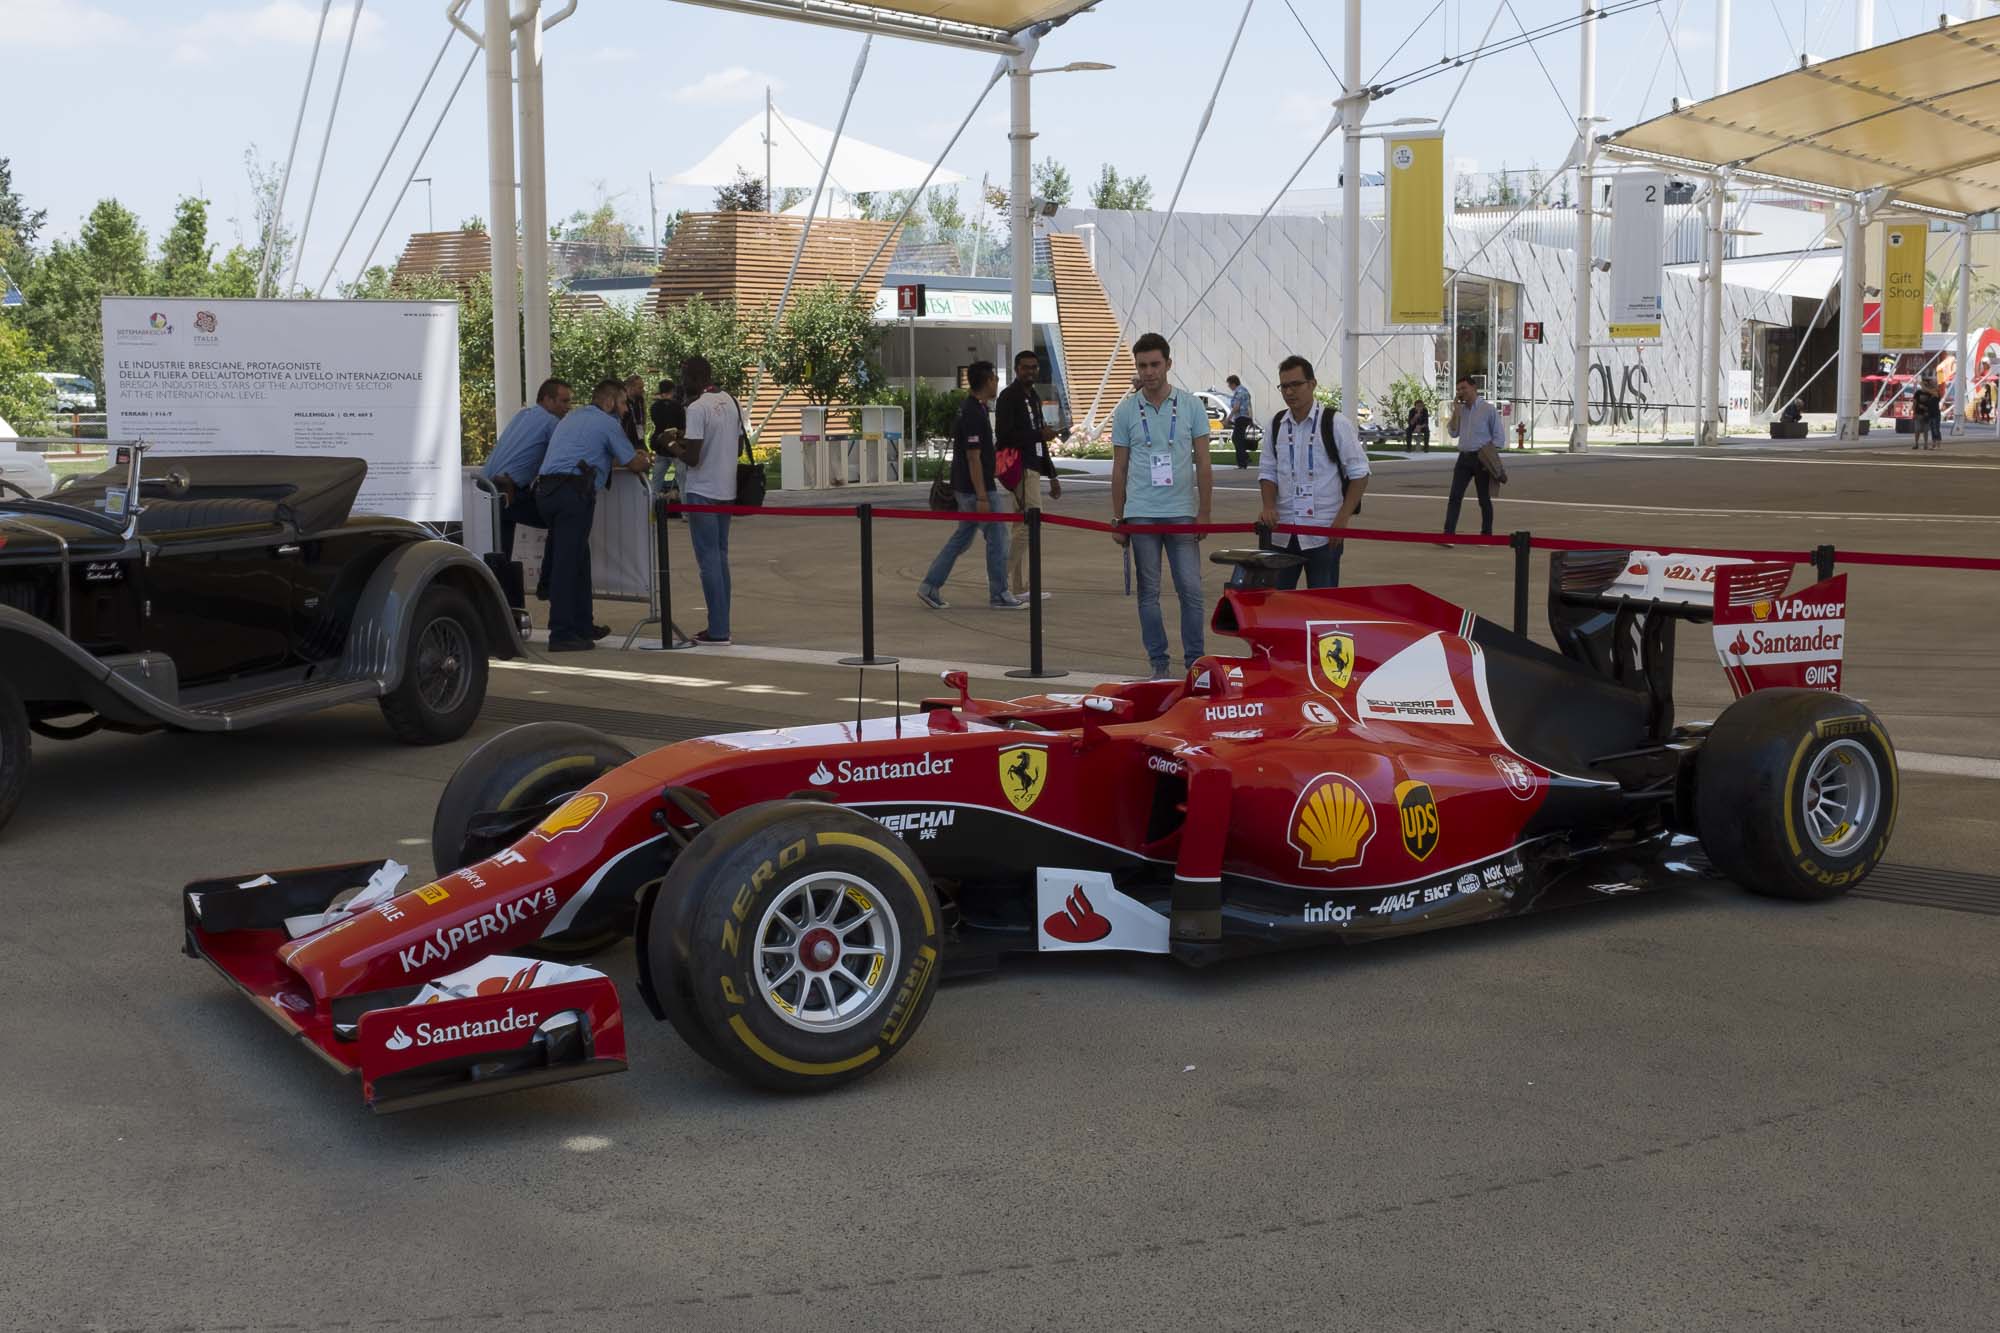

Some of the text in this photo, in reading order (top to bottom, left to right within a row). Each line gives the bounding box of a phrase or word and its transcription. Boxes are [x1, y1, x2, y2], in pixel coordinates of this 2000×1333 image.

[1645, 185, 1657, 203] 2
[1889, 272, 1912, 285] Gift
[1889, 286, 1921, 300] Shop
[924, 297, 952, 314] TESA
[118, 361, 321, 371] LE INDUSTRIE BRESCIANE, PROTAGONISTE
[119, 370, 150, 379] DELLA
[153, 371, 189, 379] FILIERA
[284, 371, 292, 380] A
[294, 372, 334, 381] LIVELLO
[336, 372, 423, 381] INTERNAZIONALE
[1497, 360, 1514, 377] OVS
[119, 381, 159, 389] BRESCIA
[222, 381, 250, 390] STARS
[252, 381, 266, 390] OF
[268, 381, 287, 390] THE
[289, 382, 353, 391] AUTOMOTIVE
[355, 382, 393, 391] SECTOR
[119, 390, 133, 399] AT
[134, 390, 153, 399] THE
[156, 390, 235, 399] INTERNATIONAL
[1588, 363, 1648, 425] OVS
[1774, 599, 1845, 620] V-Power
[1751, 624, 1842, 655] Santander
[1205, 702, 1264, 721] HUBLOT
[1367, 699, 1436, 708] SCUDERIA
[1396, 707, 1456, 716] FERRARI
[837, 751, 954, 783] Santander
[1402, 801, 1437, 850] ups
[1482, 864, 1504, 883] NGK
[1800, 858, 1867, 887] ZERO
[1369, 889, 1421, 914] HAAS
[1424, 883, 1453, 904] SKF
[719, 838, 807, 1005] P ZERO
[1303, 901, 1356, 923] infor
[399, 891, 542, 974] KASPERSKY
[416, 1007, 539, 1047] Santander
